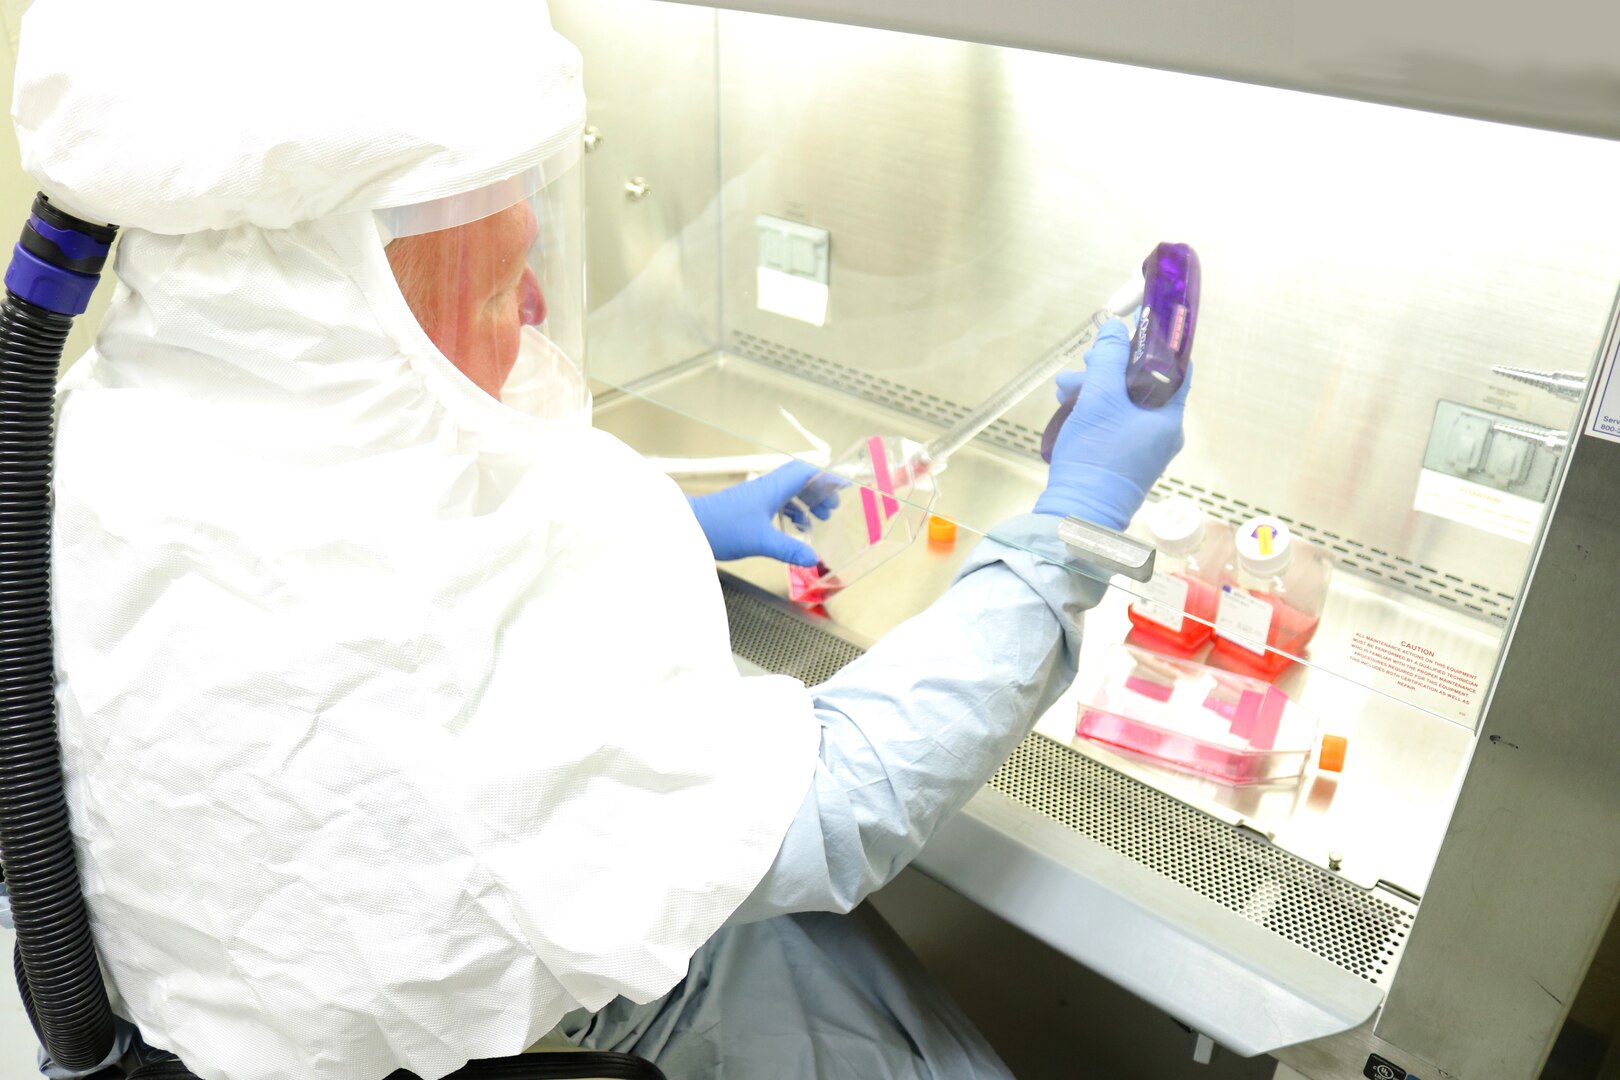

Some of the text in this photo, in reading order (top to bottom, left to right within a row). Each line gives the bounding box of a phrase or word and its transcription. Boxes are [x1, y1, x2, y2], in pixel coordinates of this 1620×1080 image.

[1354, 651, 1387, 666] PROCEDURES
[1389, 664, 1413, 676] REQUIRED
[1366, 636, 1401, 652] MAINTENANCE
[1402, 649, 1424, 660] ACTIONS
[1447, 665, 1476, 679] EQUIPMENT
[1375, 646, 1405, 660] PERFORMED
[1419, 662, 1446, 675] QUALIFIED
[1447, 672, 1478, 687] TECHNICIAN
[1401, 640, 1434, 657] CAUTION
[1361, 660, 1385, 672] INCLUDES
[1401, 675, 1438, 692] CERTIFICATION
[1370, 650, 1391, 661] FAMILIAR
[1417, 668, 1438, 679] PROPER
[1439, 676, 1476, 693] MAINTENANCE
